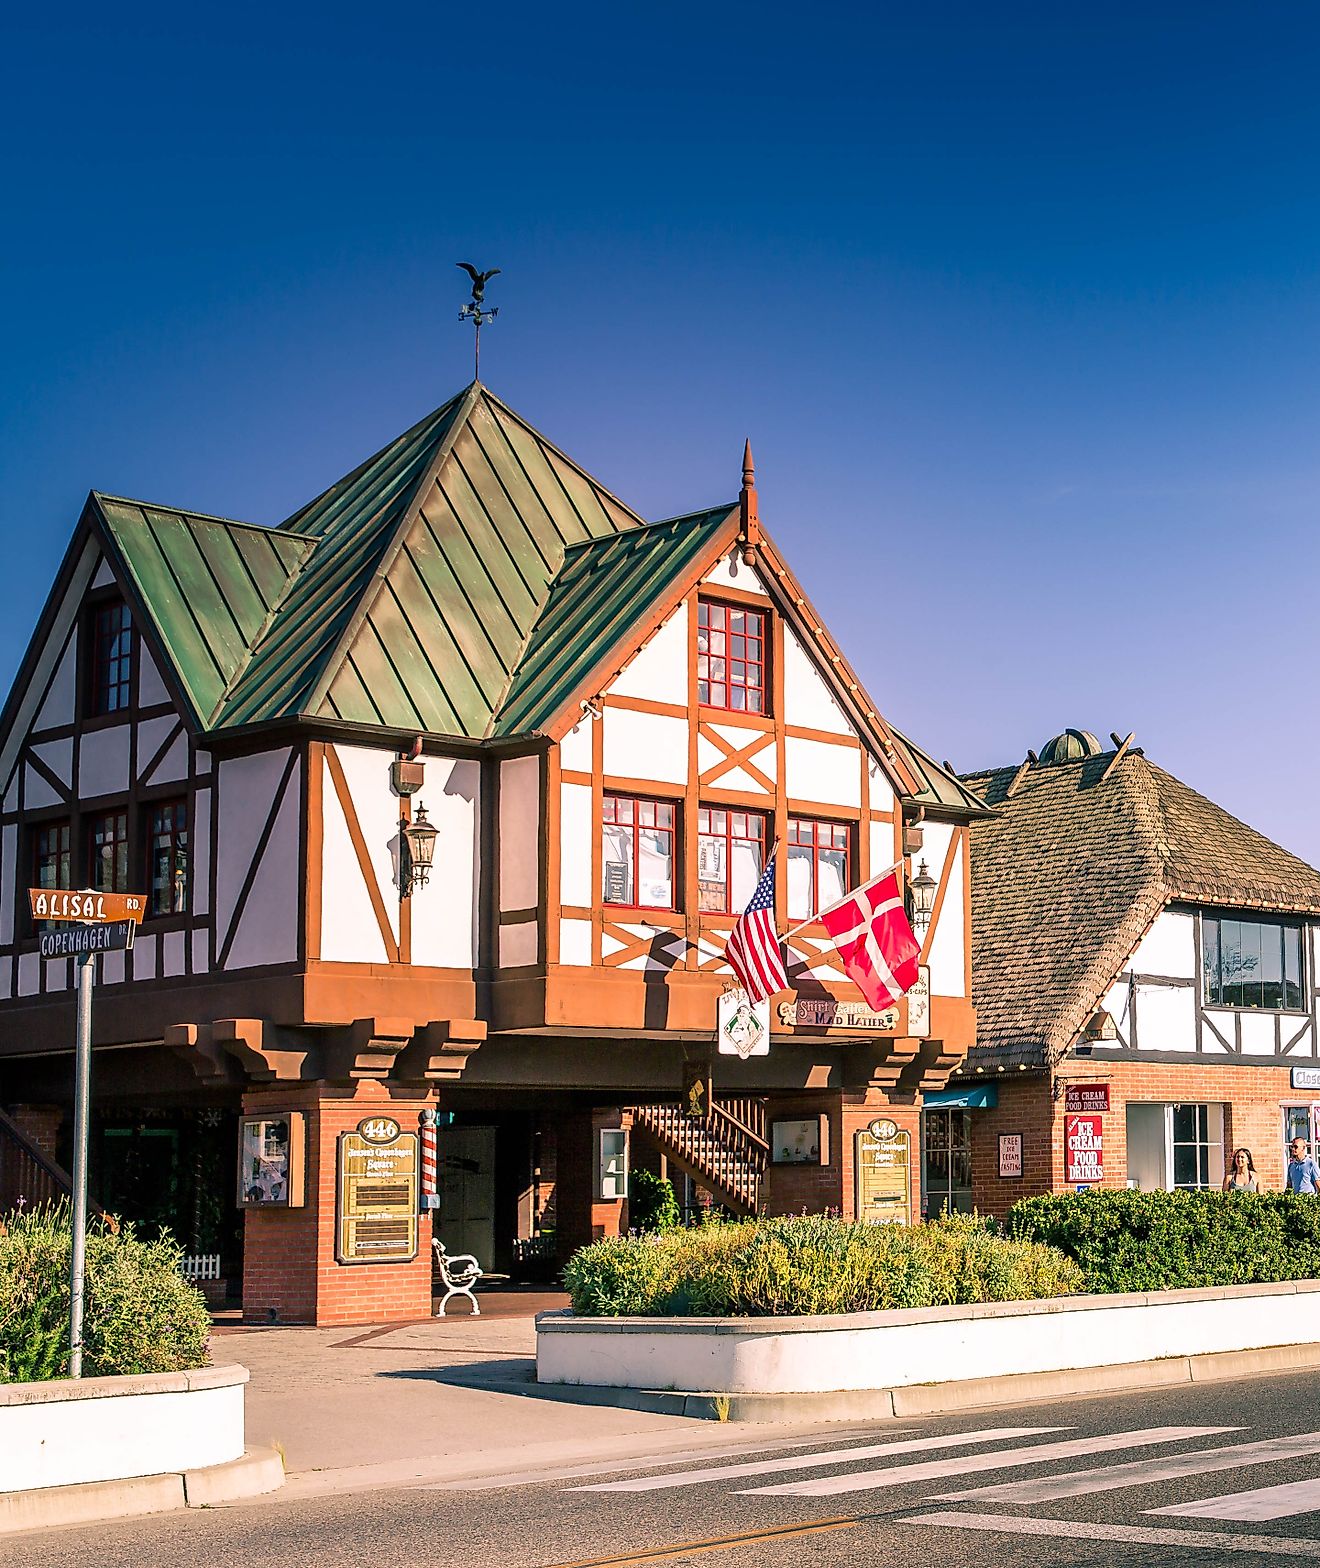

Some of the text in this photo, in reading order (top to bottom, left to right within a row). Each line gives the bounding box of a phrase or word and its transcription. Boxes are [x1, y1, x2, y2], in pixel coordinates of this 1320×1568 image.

[36, 893, 141, 919] ALISAL RD.
[41, 926, 111, 956] COPENHAGEN
[799, 1000, 829, 1018] Shirt
[815, 1012, 843, 1025] MAD
[1068, 1091, 1105, 1101] ICE CREAM
[1065, 1101, 1108, 1111] FOOD DRINKS
[365, 1121, 397, 1138] 446
[873, 1122, 895, 1137] 446
[1077, 1121, 1094, 1136] ICE
[1003, 1137, 1018, 1146] FREE
[1069, 1136, 1103, 1151] CREAM
[1073, 1151, 1098, 1166] FOOD
[1001, 1163, 1021, 1172] TASTING
[1069, 1165, 1104, 1180] DRINKS
